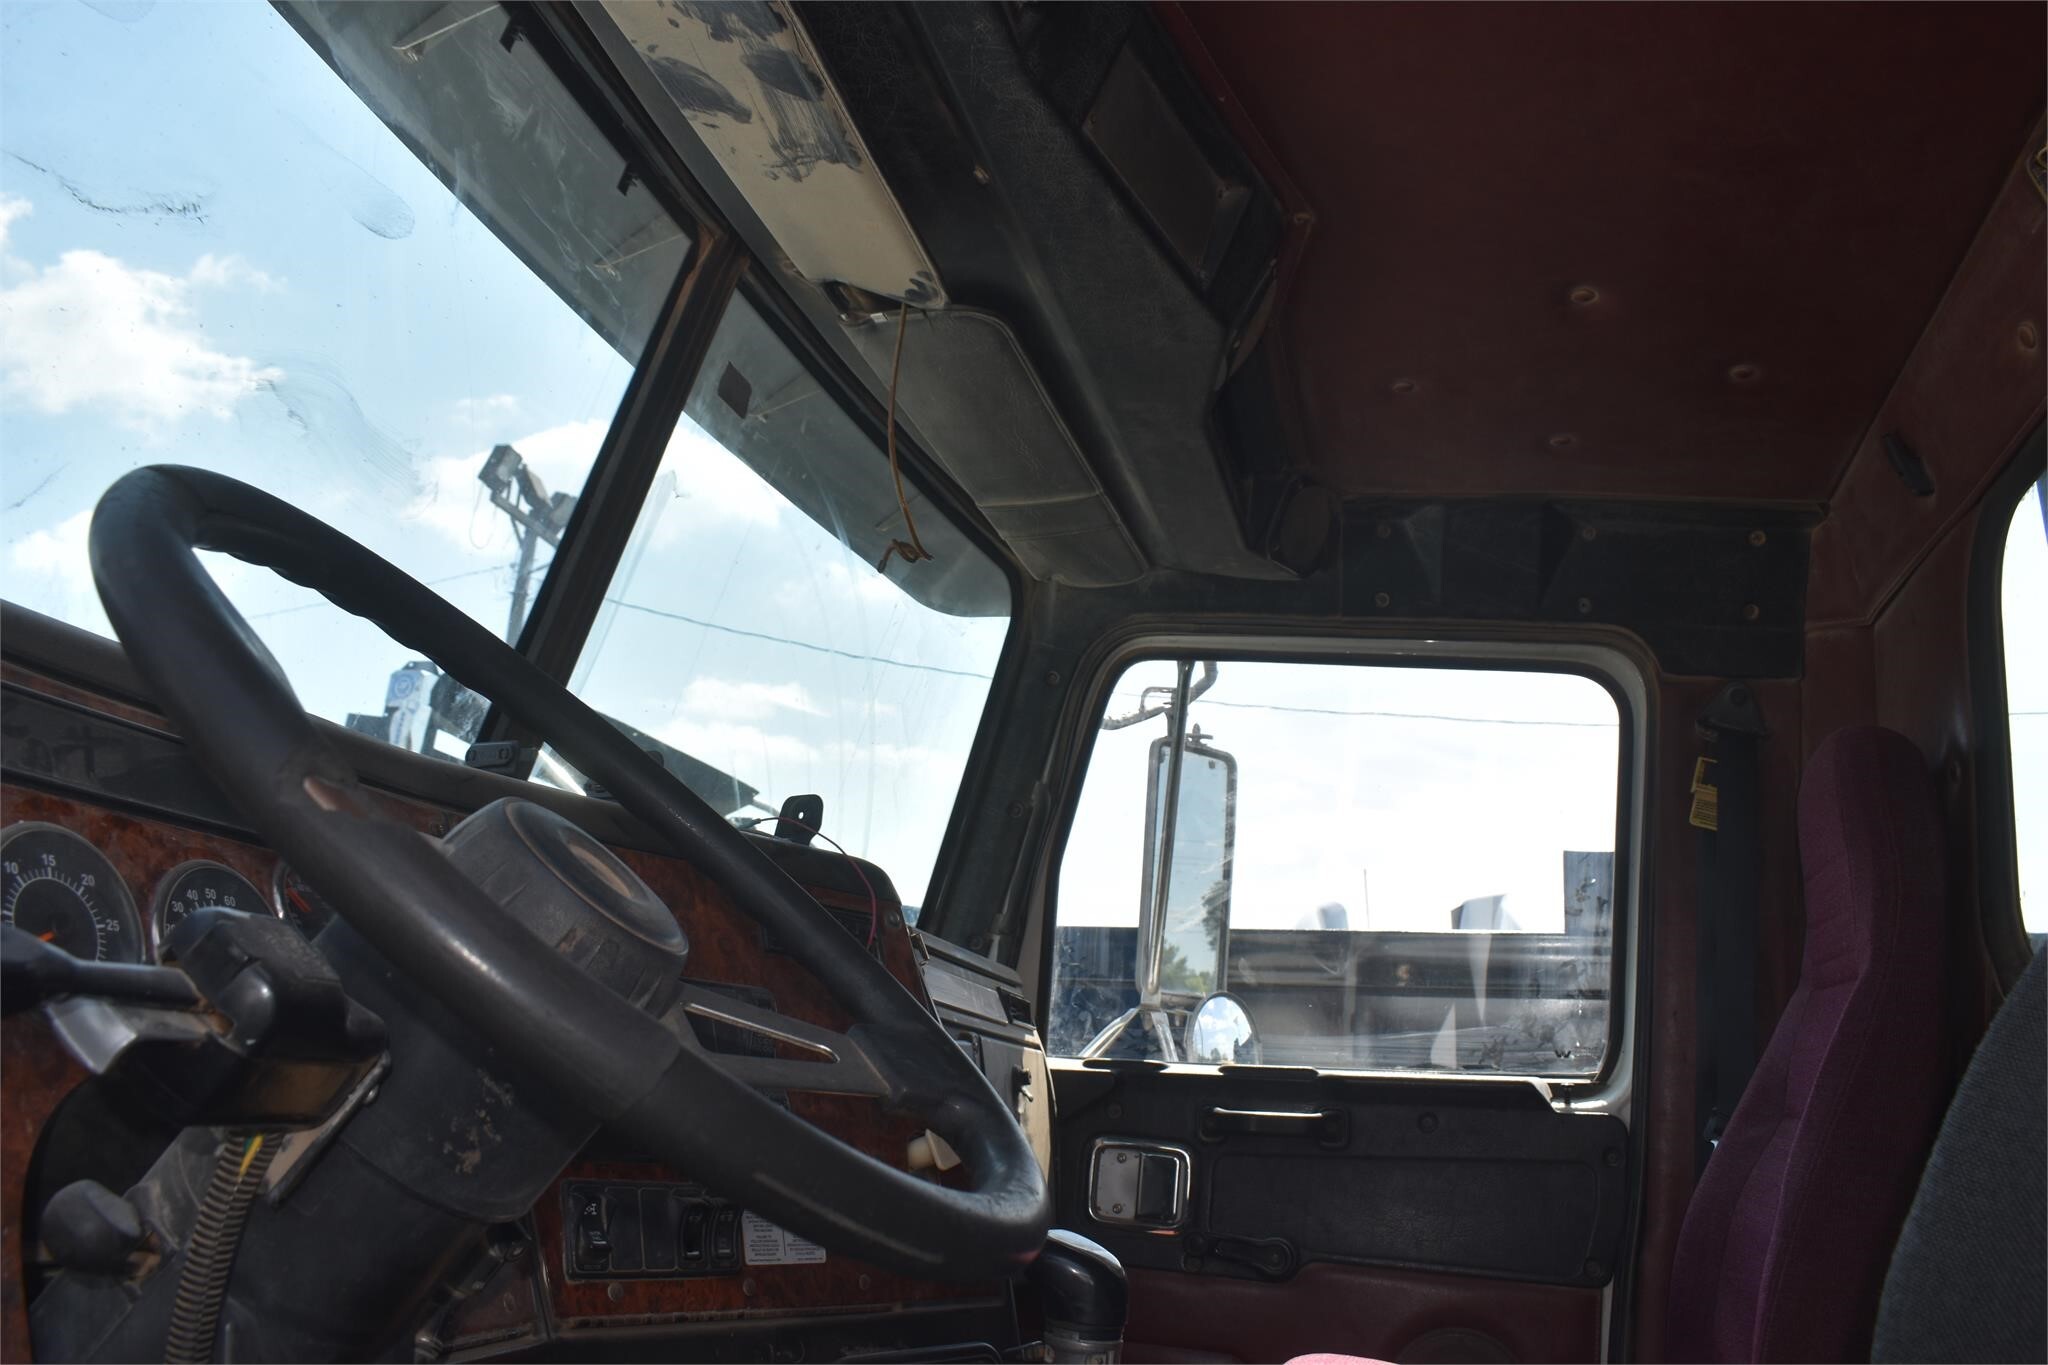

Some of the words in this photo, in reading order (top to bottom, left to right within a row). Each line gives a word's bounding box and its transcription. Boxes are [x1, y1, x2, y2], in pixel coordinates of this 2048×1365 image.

[41, 853, 56, 867] 15
[4, 861, 19, 874] 10
[80, 873, 95, 887] 20
[186, 888, 198, 900] 40
[204, 887, 217, 899] 50
[171, 900, 184, 913] 30
[105, 919, 120, 932] 25
